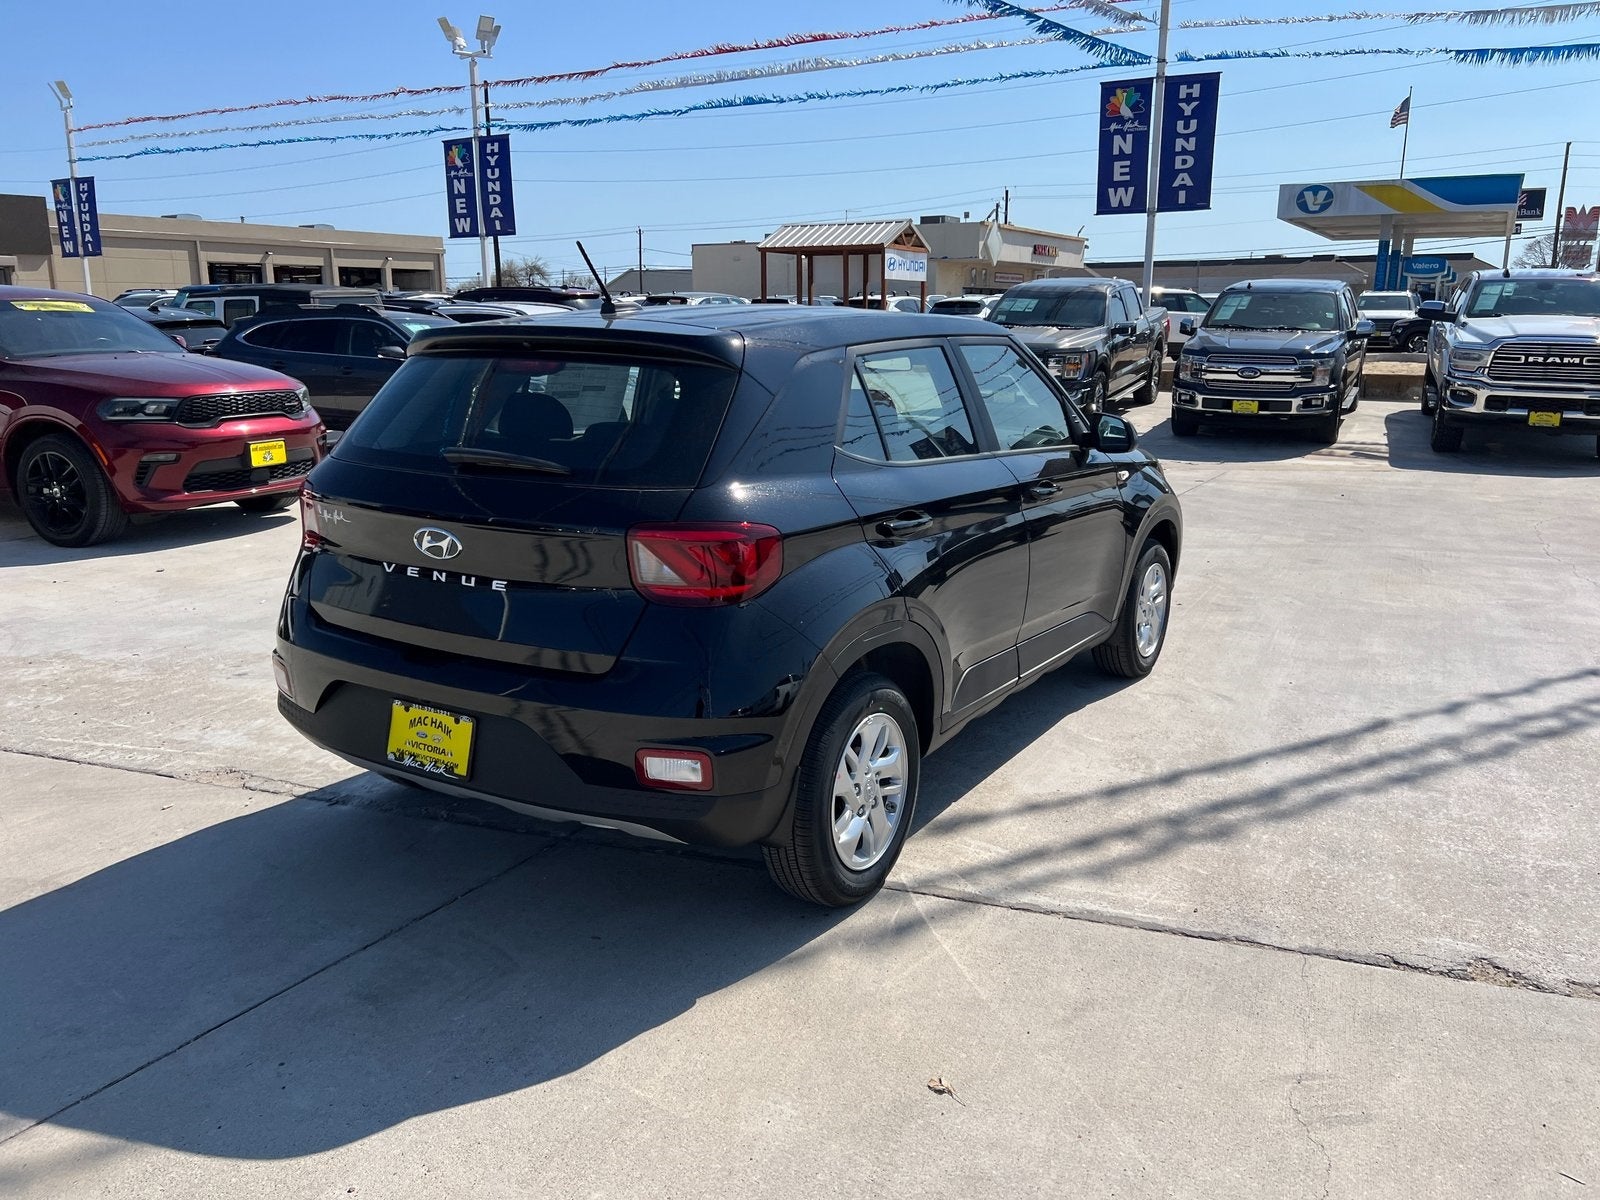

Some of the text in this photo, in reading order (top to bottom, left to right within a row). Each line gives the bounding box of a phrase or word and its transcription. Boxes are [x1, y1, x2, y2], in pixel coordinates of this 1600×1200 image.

[1171, 83, 1201, 204] HYUNDAI
[485, 142, 504, 231] HYUNDAI
[1108, 133, 1135, 208] NEW
[79, 182, 93, 252] HYUNDAI
[453, 178, 471, 233] NEW
[58, 210, 74, 253] NEW
[898, 259, 926, 273] HYUNDAI
[1528, 356, 1580, 364] RAM
[382, 562, 508, 592] VENUE
[408, 715, 429, 729] MAC
[430, 717, 453, 740] HAIK
[410, 740, 447, 757] VICTORIA
